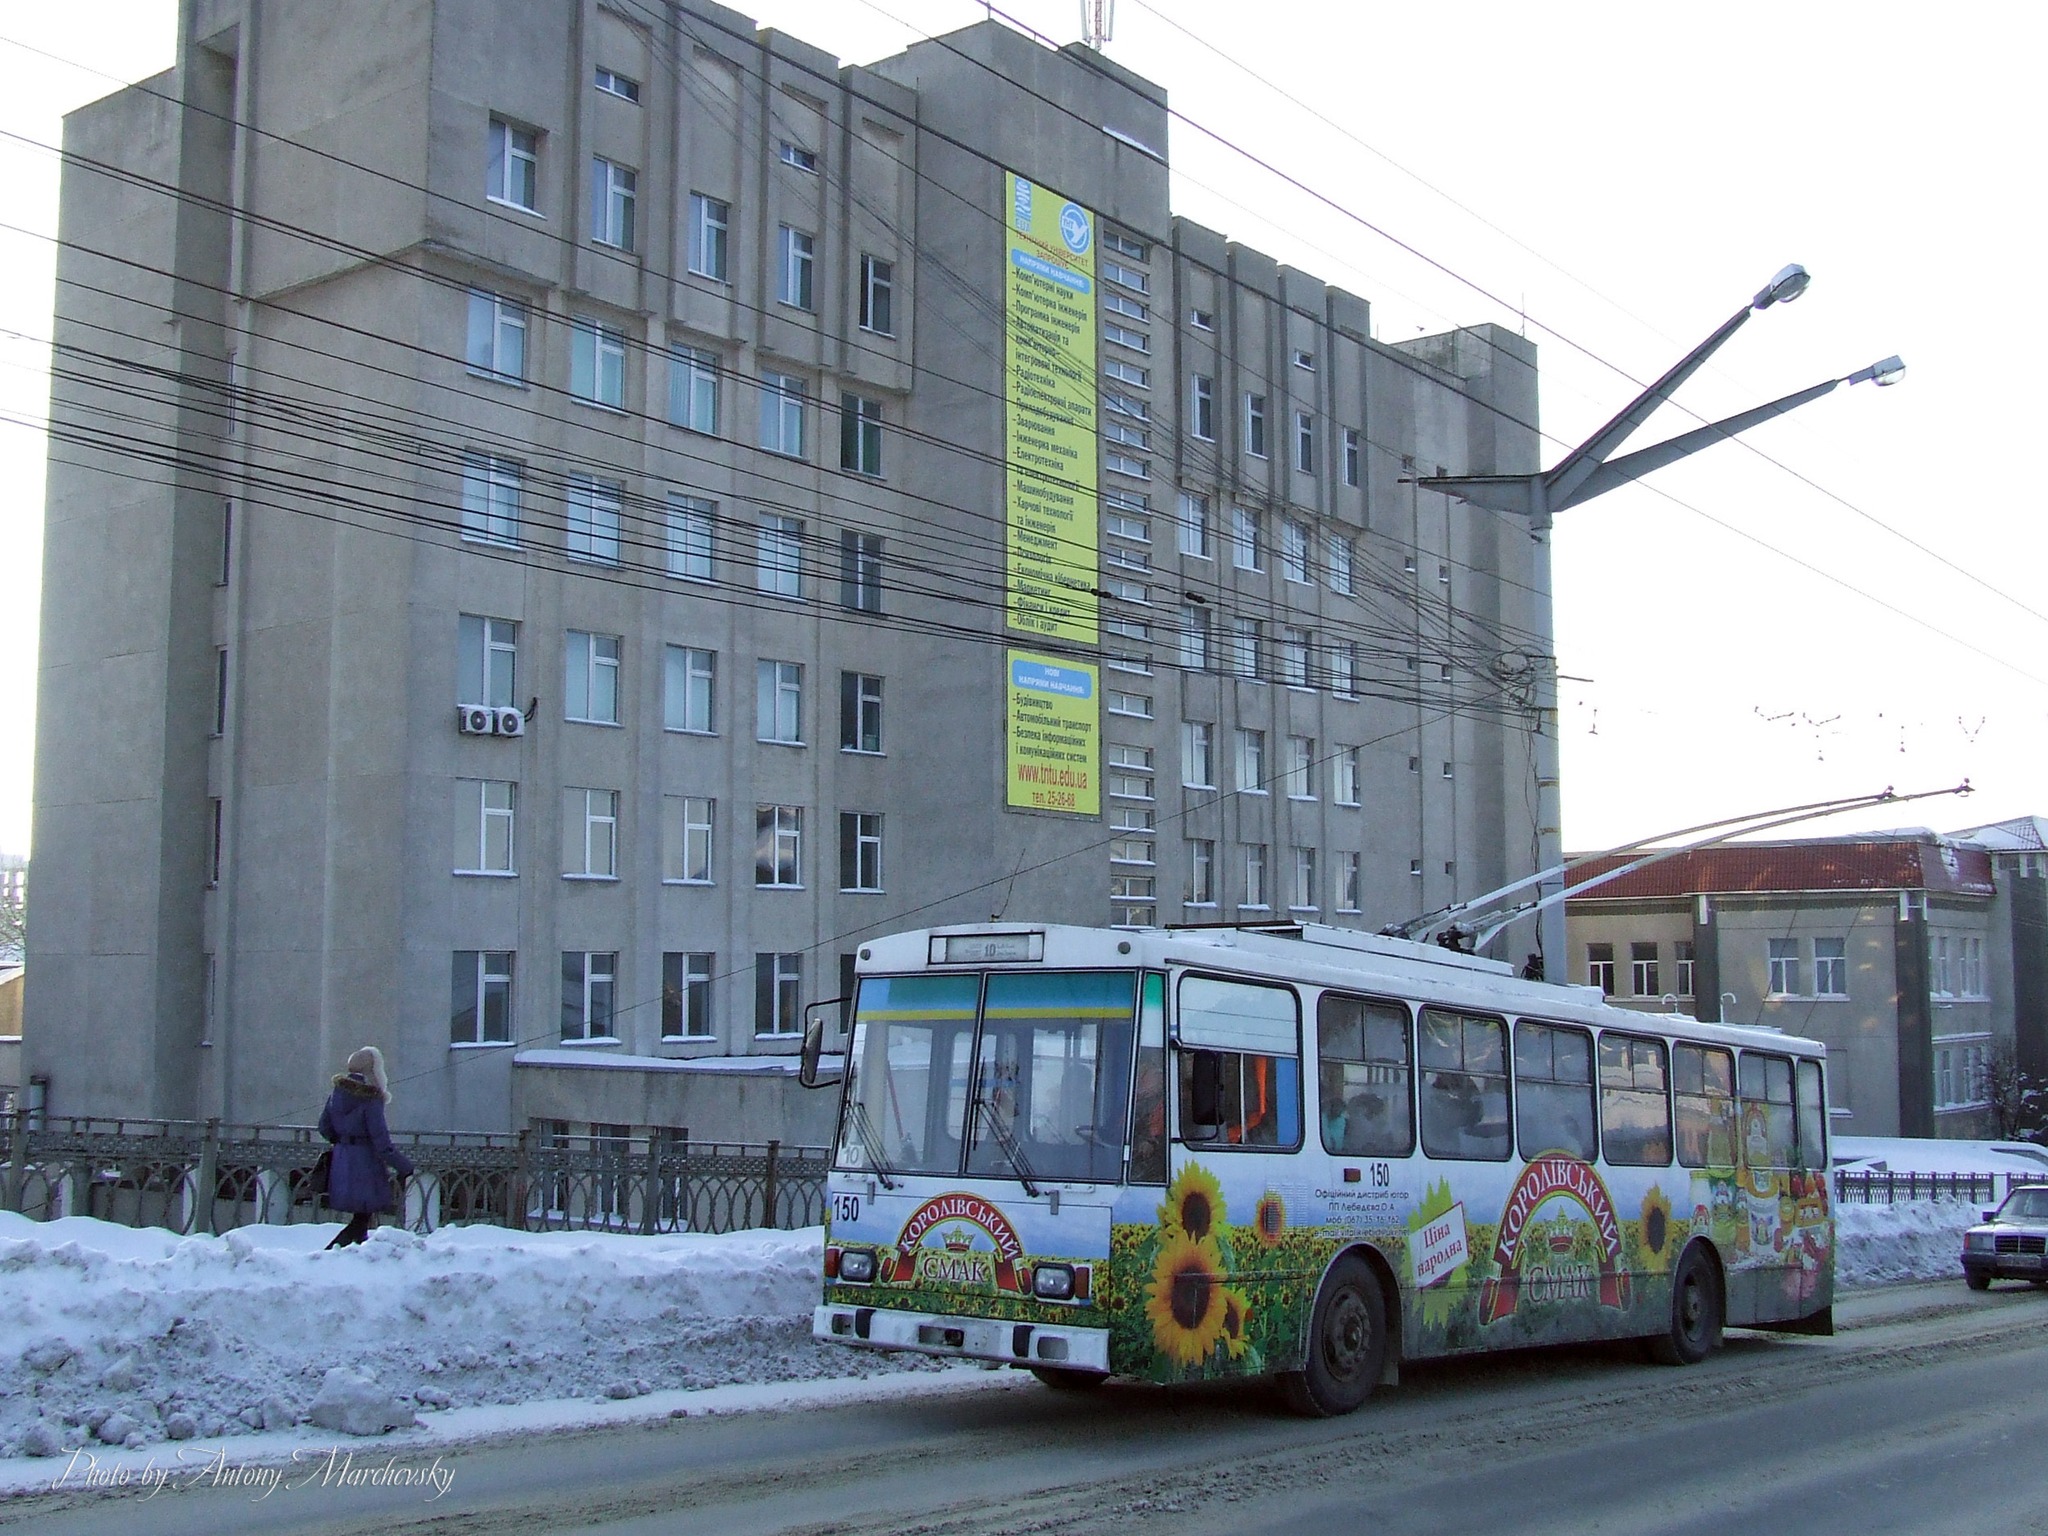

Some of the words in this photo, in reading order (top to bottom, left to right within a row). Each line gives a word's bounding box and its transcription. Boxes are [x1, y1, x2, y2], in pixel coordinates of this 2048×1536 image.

[1017, 763, 1088, 790] www.tntu.edu.ua
[984, 943, 997, 957] 10
[844, 1146, 860, 1164] 10
[1370, 1161, 1390, 1187] 150
[834, 1195, 860, 1222] 150
[1328, 1202, 1340, 1212] ПП
[1500, 1161, 1619, 1261] КОРОЛІВСЬКИЙ
[900, 1199, 1020, 1261] КОРОЛІВСЬКИЙ
[1424, 1222, 1451, 1251] Ціна
[923, 1257, 987, 1283] СМАК
[1417, 1239, 1463, 1277] народна
[1529, 1265, 1594, 1304] СМАК
